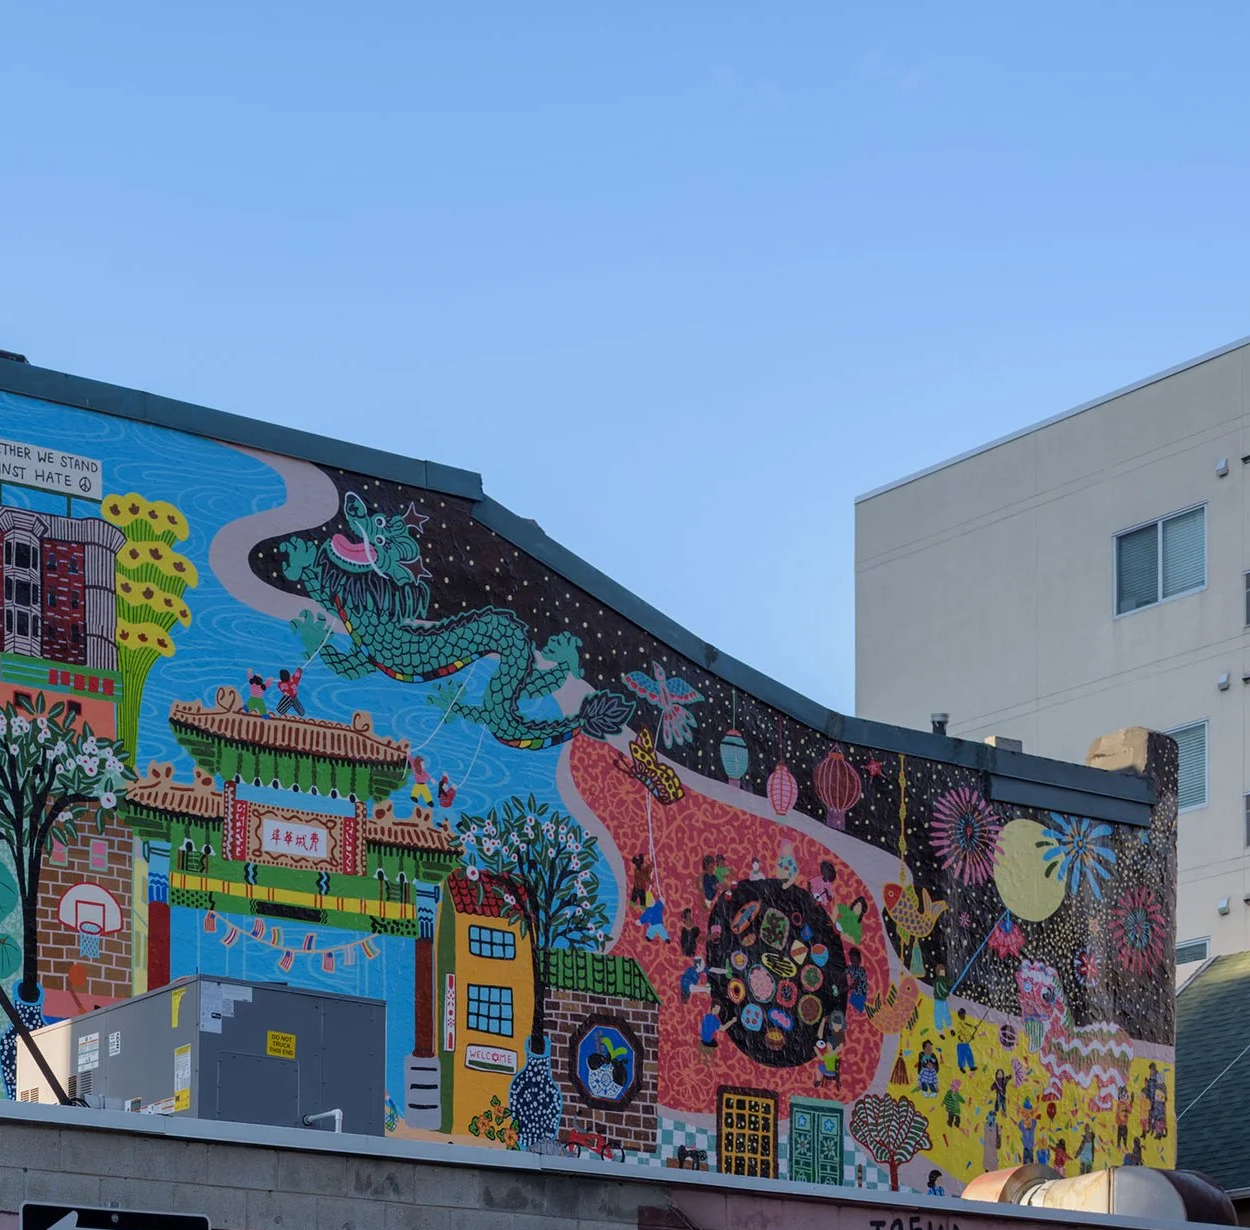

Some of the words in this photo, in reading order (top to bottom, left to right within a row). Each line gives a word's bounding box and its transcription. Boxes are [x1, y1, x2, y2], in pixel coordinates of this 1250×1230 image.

[36, 451, 54, 464] WE
[59, 455, 99, 474] STAND
[34, 469, 73, 487] HATE
[269, 1046, 282, 1054] THIS
[272, 1041, 291, 1049] TRUCK
